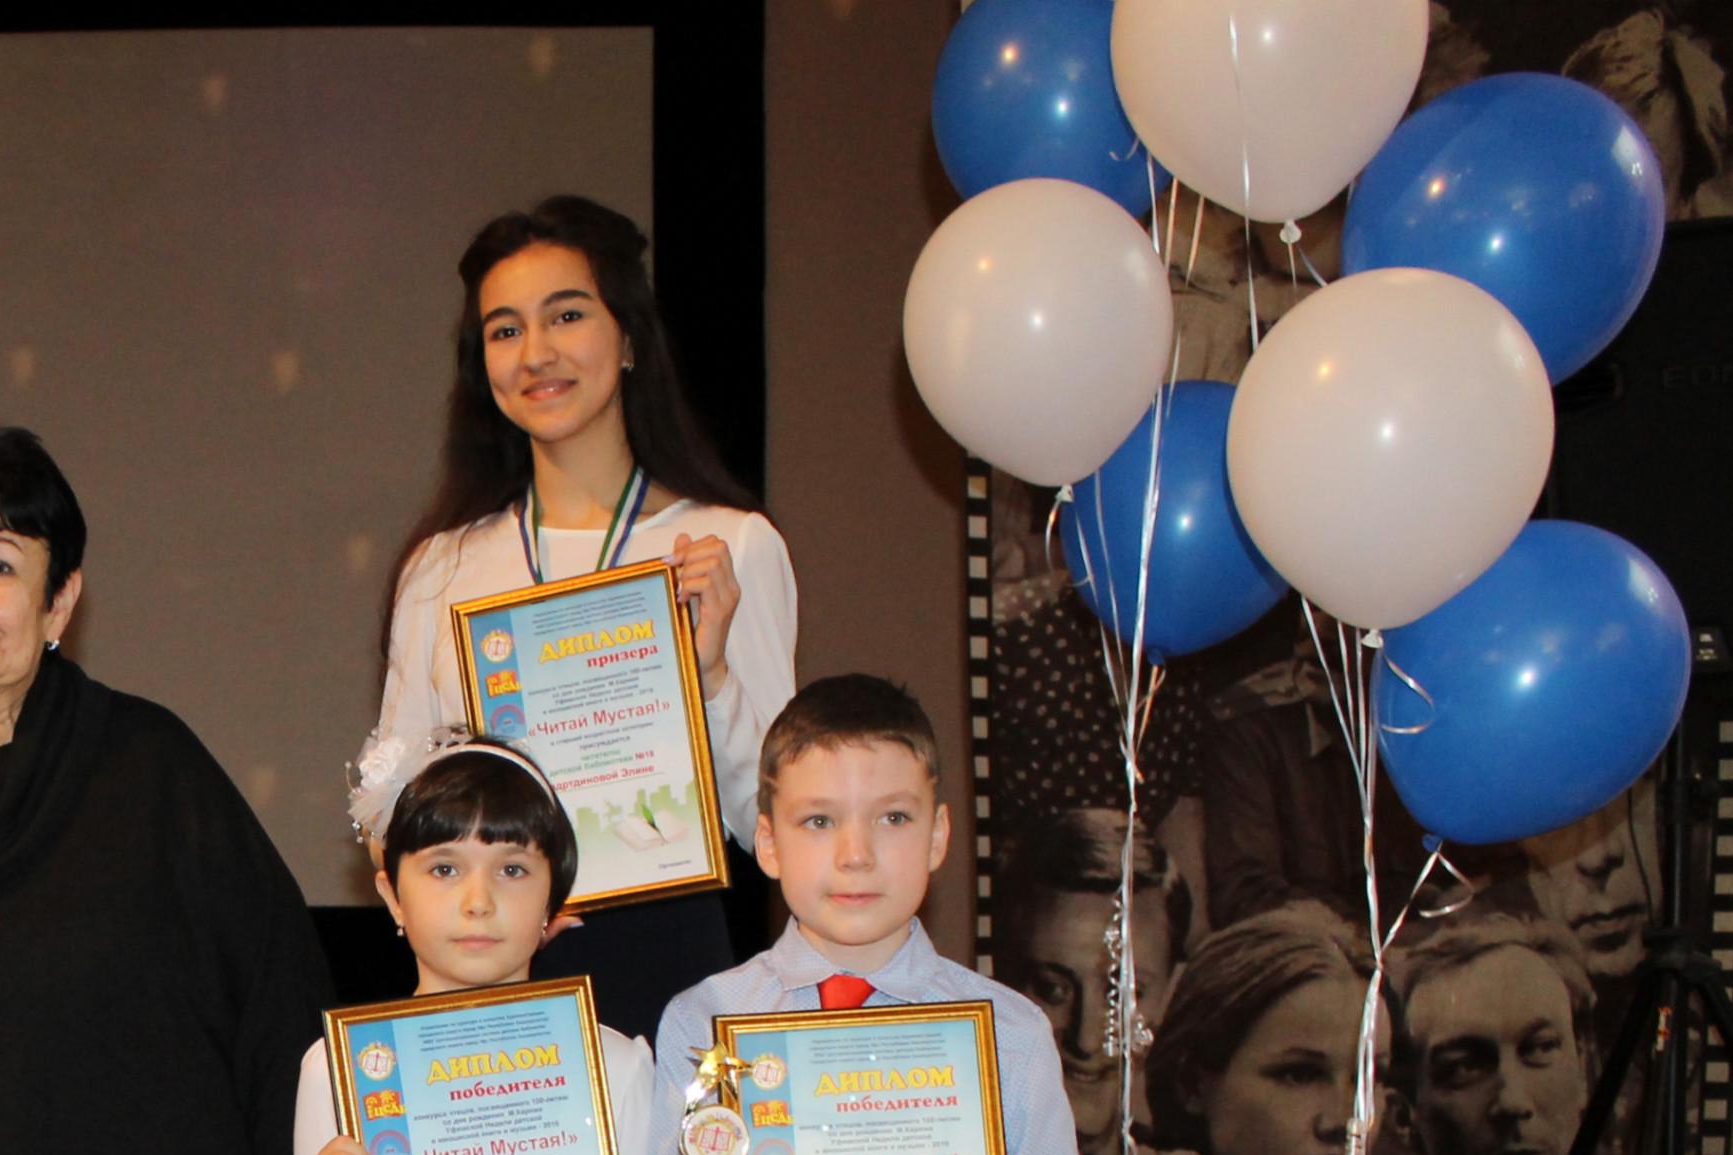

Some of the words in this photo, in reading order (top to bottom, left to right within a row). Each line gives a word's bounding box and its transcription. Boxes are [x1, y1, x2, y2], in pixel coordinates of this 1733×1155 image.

[537, 620, 656, 663] ДИПЛОМ
[586, 645, 659, 669] призера
[528, 714, 588, 738] «Читай
[592, 697, 670, 727] Мустая!»
[424, 1045, 561, 1083] ДИПЛОМ
[448, 1075, 565, 1099] победителя
[813, 1065, 955, 1096] ДИПЛОМ
[835, 1092, 957, 1113] победителя
